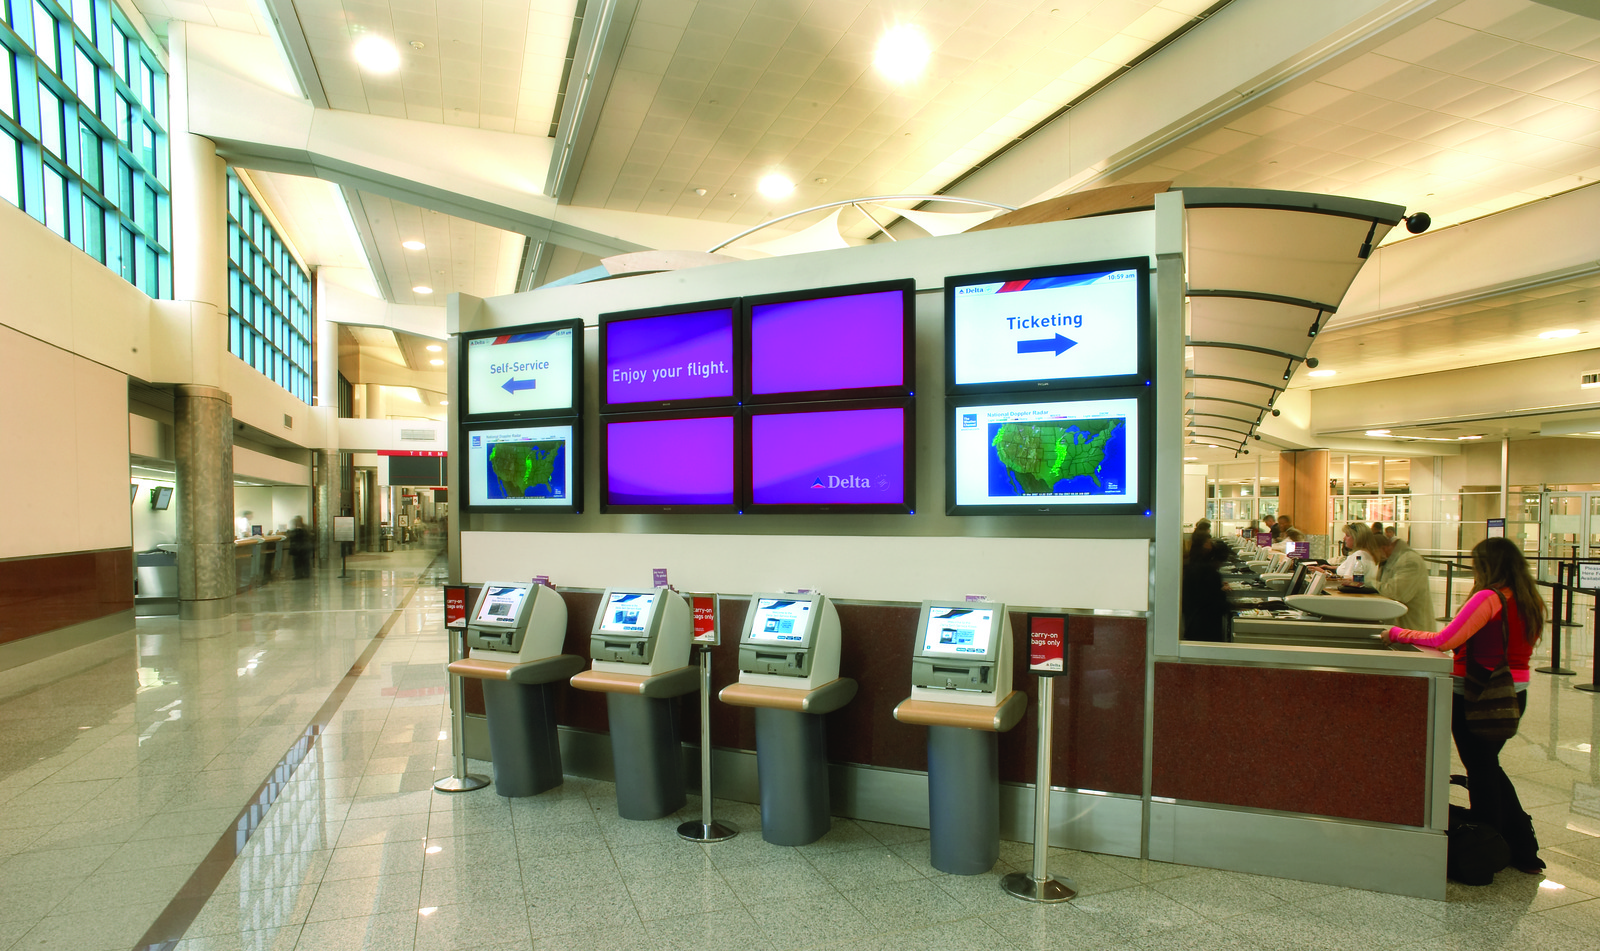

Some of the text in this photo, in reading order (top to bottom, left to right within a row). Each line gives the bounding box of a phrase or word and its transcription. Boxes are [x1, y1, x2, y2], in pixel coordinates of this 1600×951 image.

[1006, 313, 1083, 330] Ticketing
[490, 360, 550, 374] Self-Service
[612, 360, 729, 384] Enjoy your flight.
[828, 475, 871, 489] Delta
[704, 613, 714, 621] only
[1030, 638, 1061, 647] bags only
